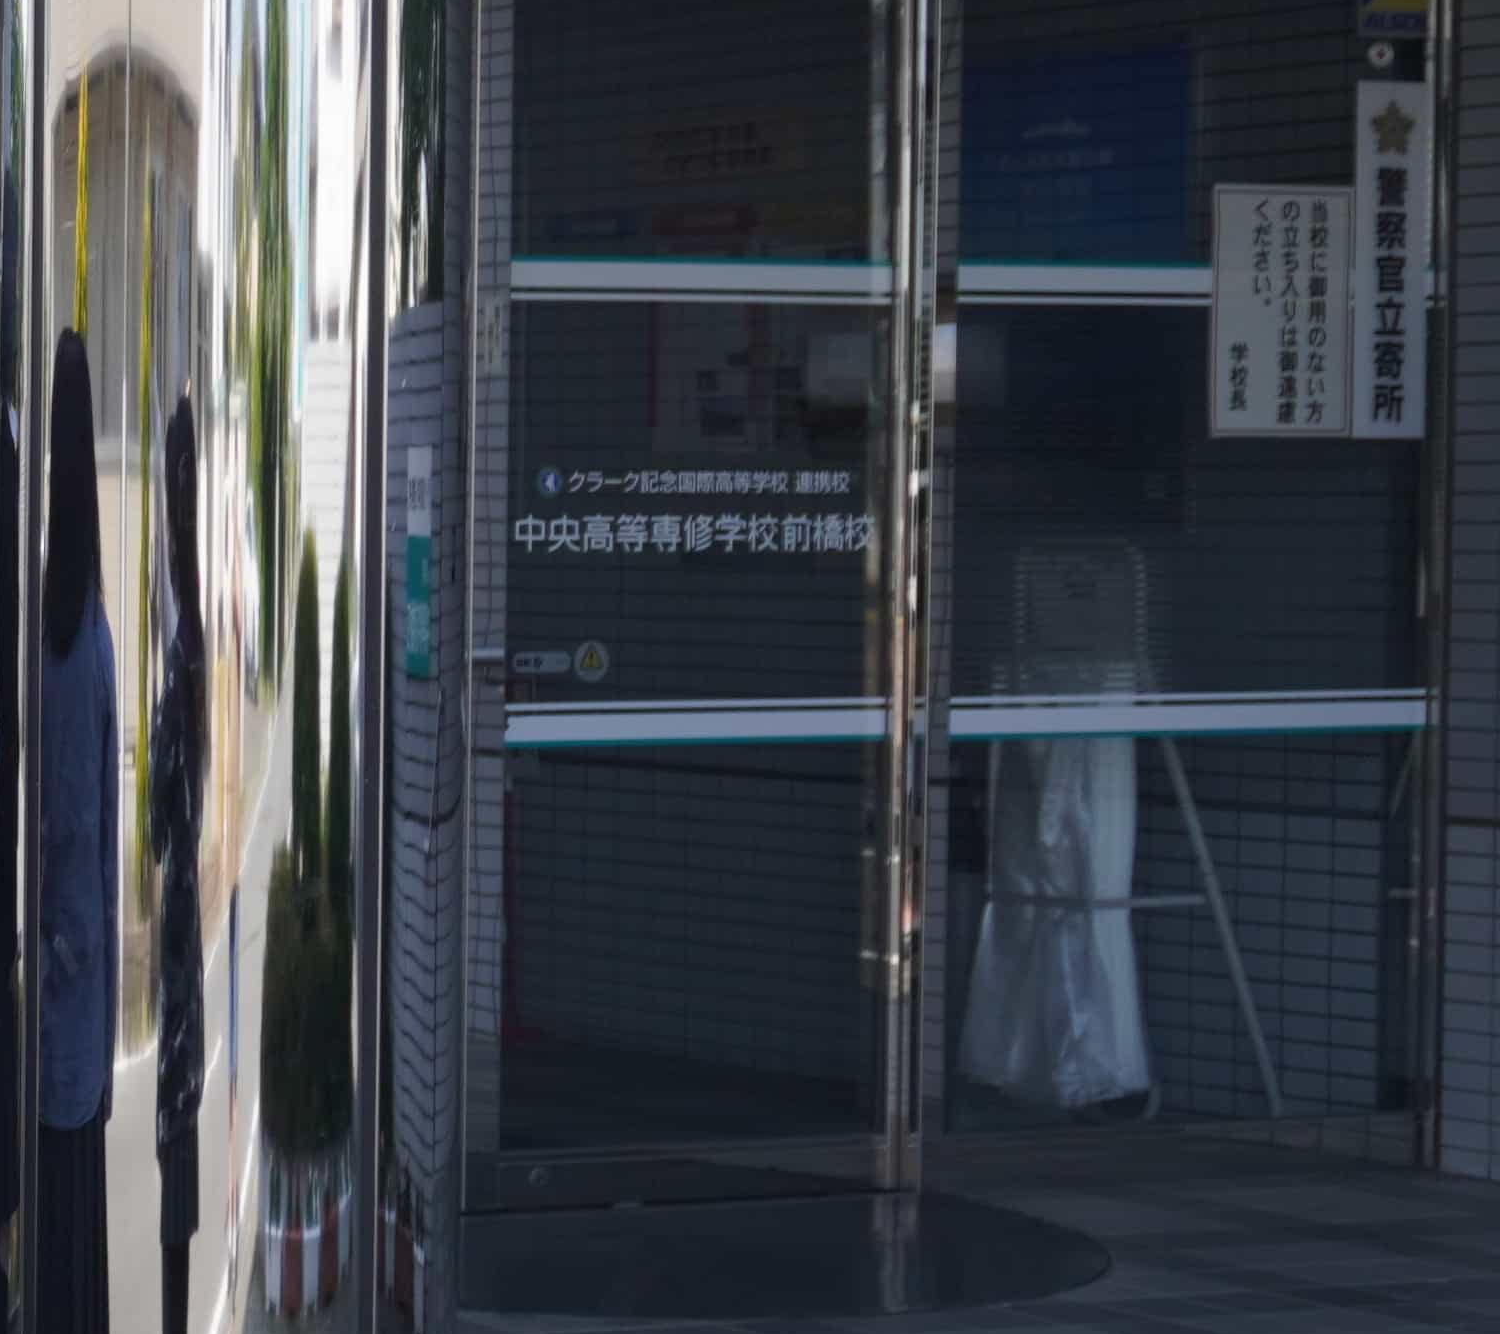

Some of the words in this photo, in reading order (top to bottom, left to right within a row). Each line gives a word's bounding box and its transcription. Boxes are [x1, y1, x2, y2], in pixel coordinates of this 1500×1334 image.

[1251, 198, 1273, 308] ください。
[1372, 167, 1408, 423] 警察官立寄所
[1276, 200, 1300, 425] の立ち入りは御遠慮
[1304, 200, 1329, 424] 当校に御用のない方
[1228, 341, 1251, 412] 学校長
[514, 513, 876, 554] 中央高等専修学校前橋校
[568, 470, 789, 495] クラーク記念国際高等学校
[795, 470, 851, 495] 連携校
